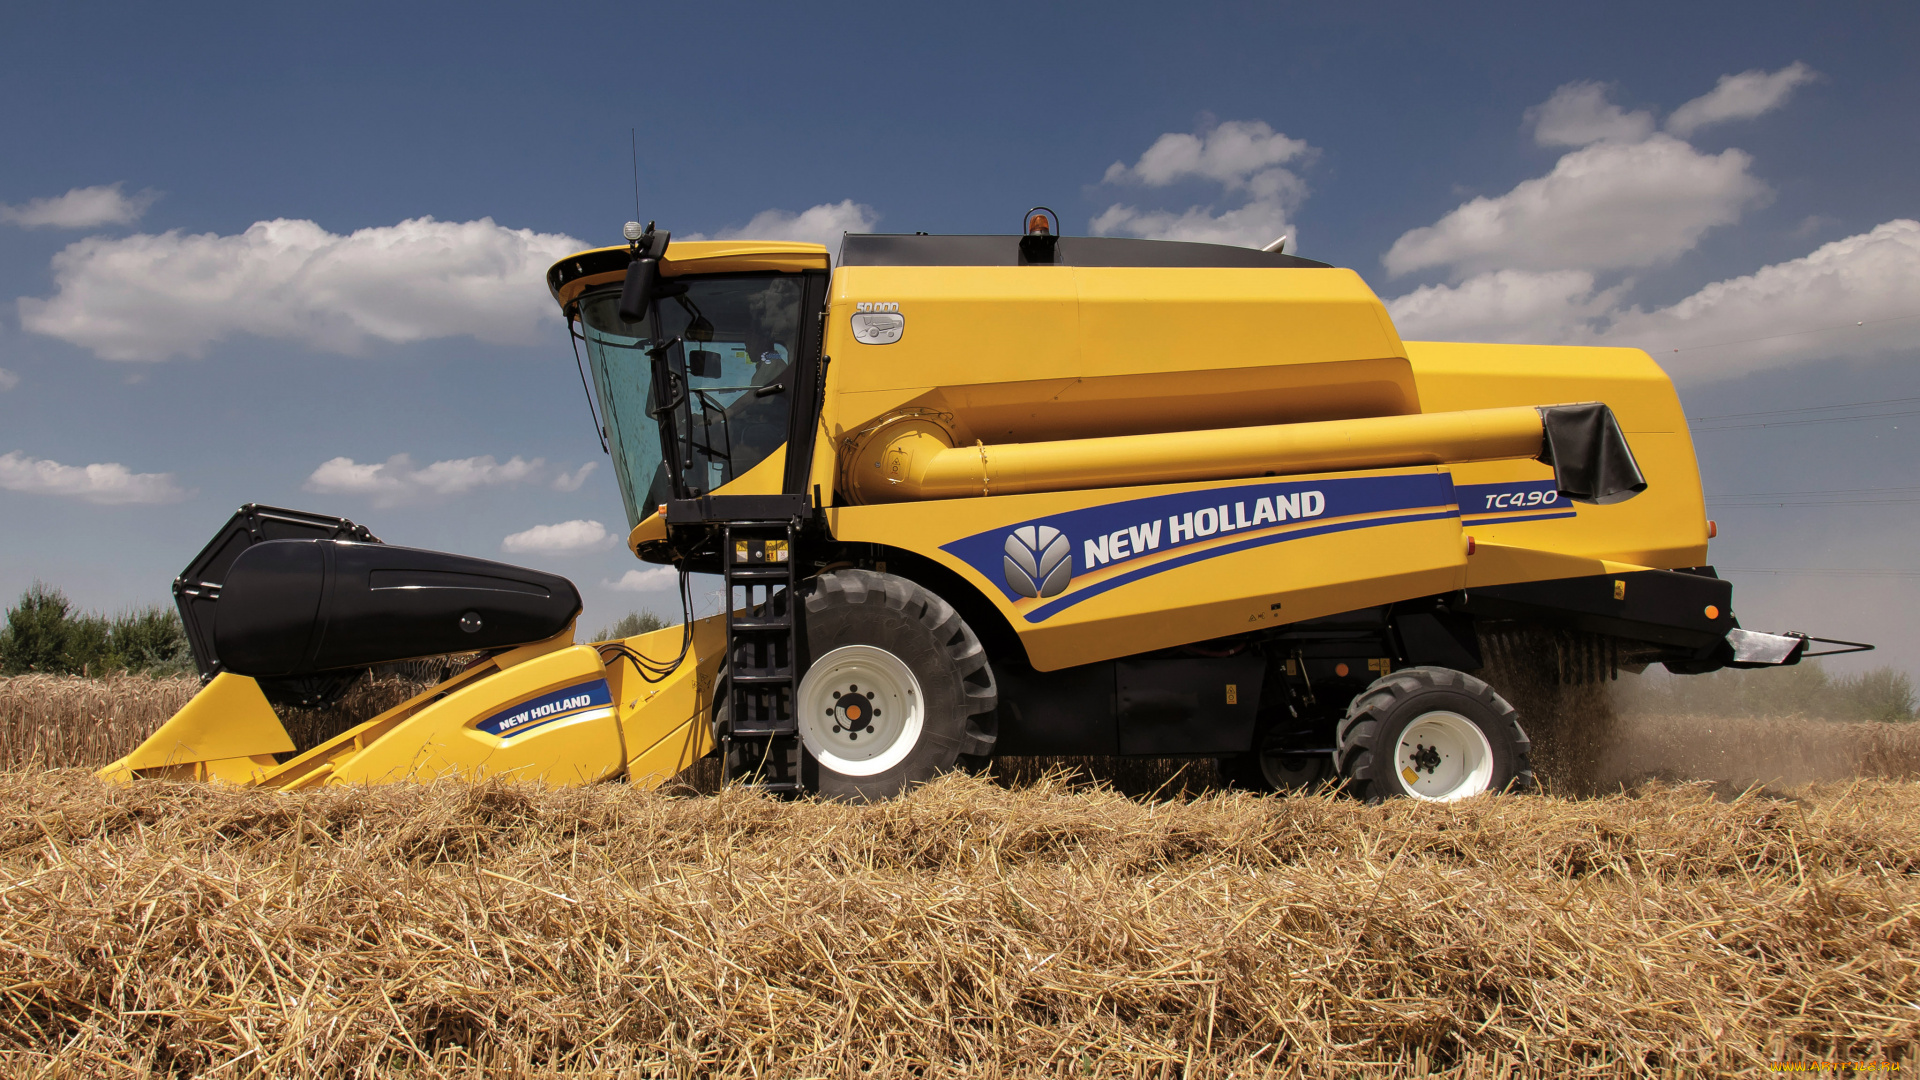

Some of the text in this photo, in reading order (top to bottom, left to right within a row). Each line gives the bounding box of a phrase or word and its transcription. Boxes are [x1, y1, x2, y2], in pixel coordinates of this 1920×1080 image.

[1485, 489, 1558, 509] TC4.90
[1084, 490, 1326, 569] NEW HOLLAND
[499, 694, 591, 731] NEW HOLLAND
